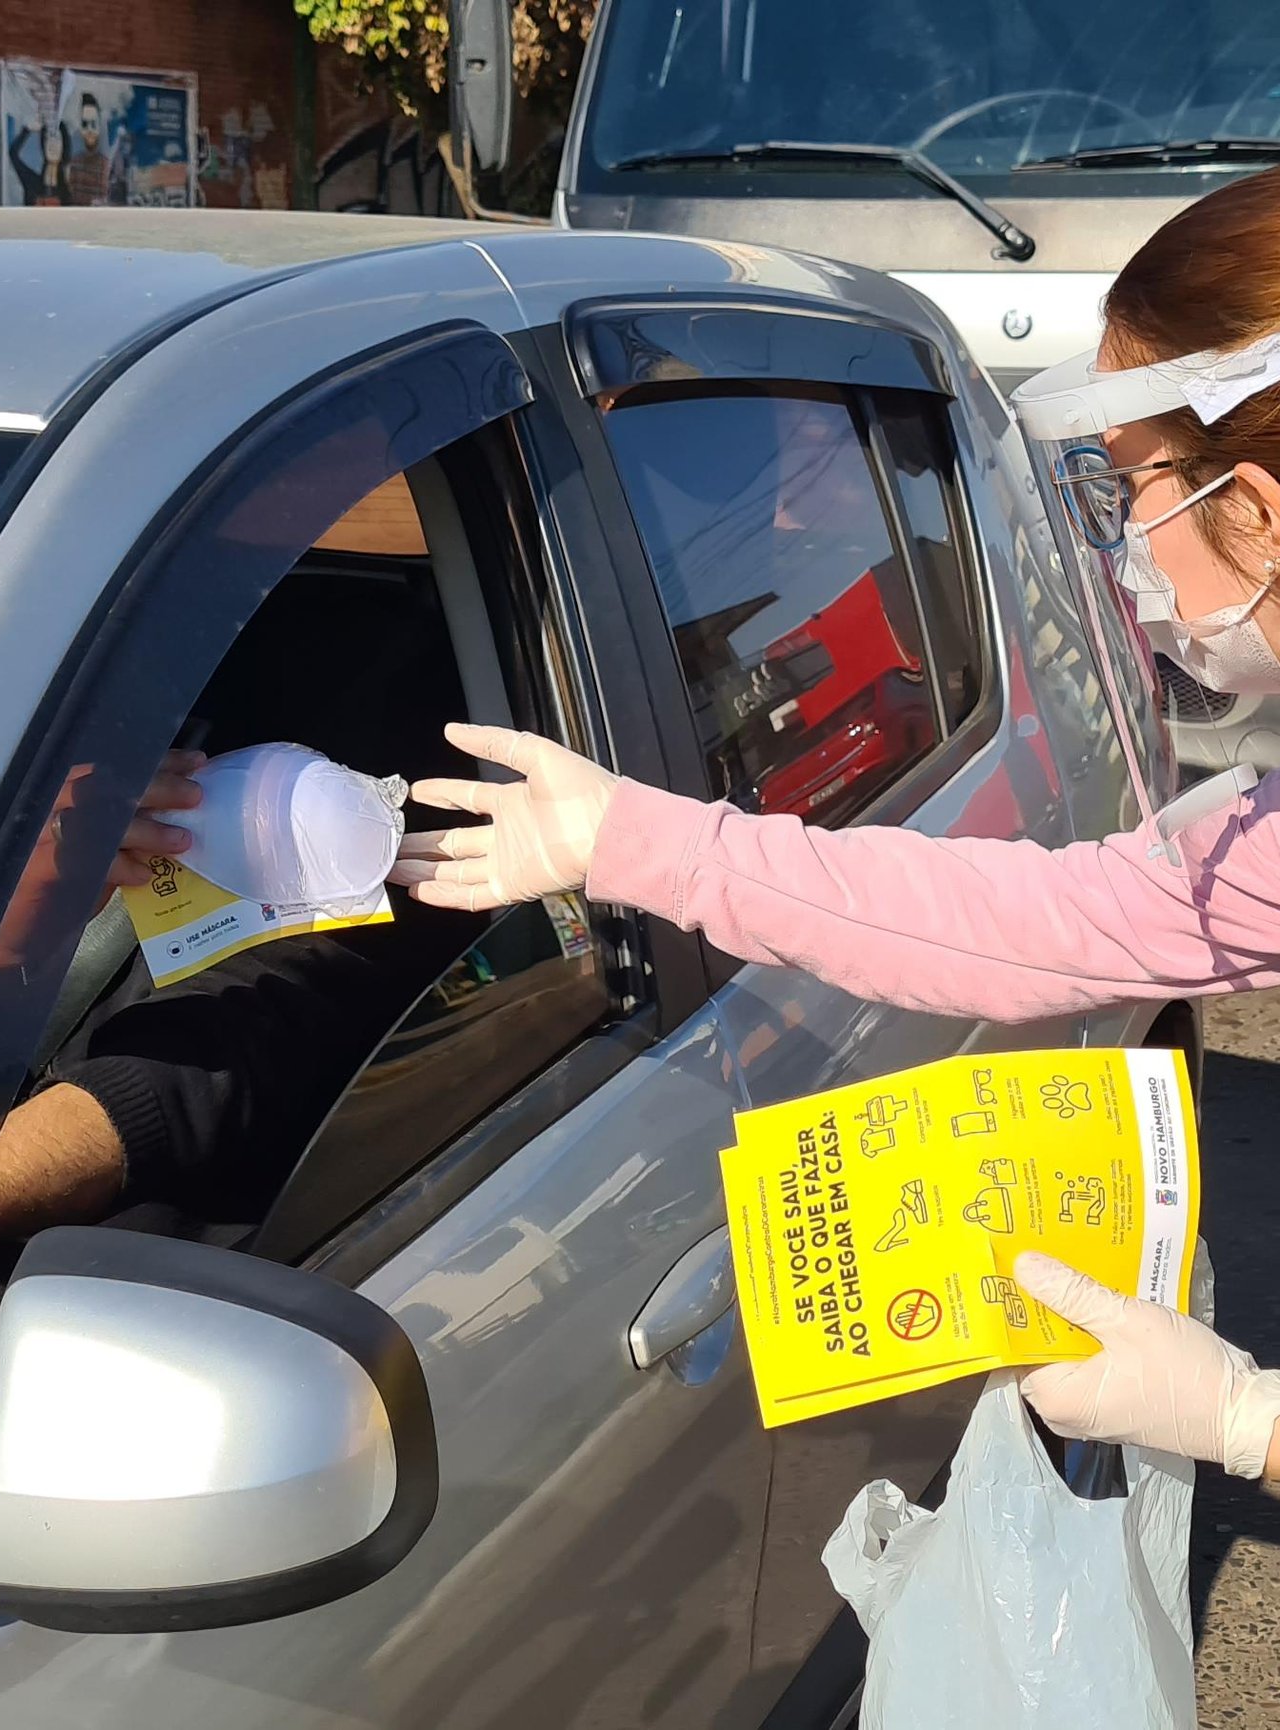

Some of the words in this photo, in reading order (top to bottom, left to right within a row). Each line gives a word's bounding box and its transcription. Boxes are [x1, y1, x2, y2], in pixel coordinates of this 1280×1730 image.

[1148, 1077, 1166, 1143] HAMBURGO
[798, 1127, 822, 1196] FAZER
[820, 1110, 842, 1174] CASA:
[1158, 1147, 1169, 1184] NOVO
[779, 1163, 802, 1219] SAIU,
[829, 1181, 849, 1214] EM
[808, 1202, 830, 1248] QUE
[783, 1225, 810, 1289] VOCÊ
[815, 1256, 832, 1274] O
[835, 1219, 862, 1312] CHEGAR
[1150, 1237, 1164, 1292] MÁSCARA.
[795, 1295, 815, 1324] SE
[820, 1281, 844, 1352] SAIBA
[848, 1322, 871, 1357] AO
